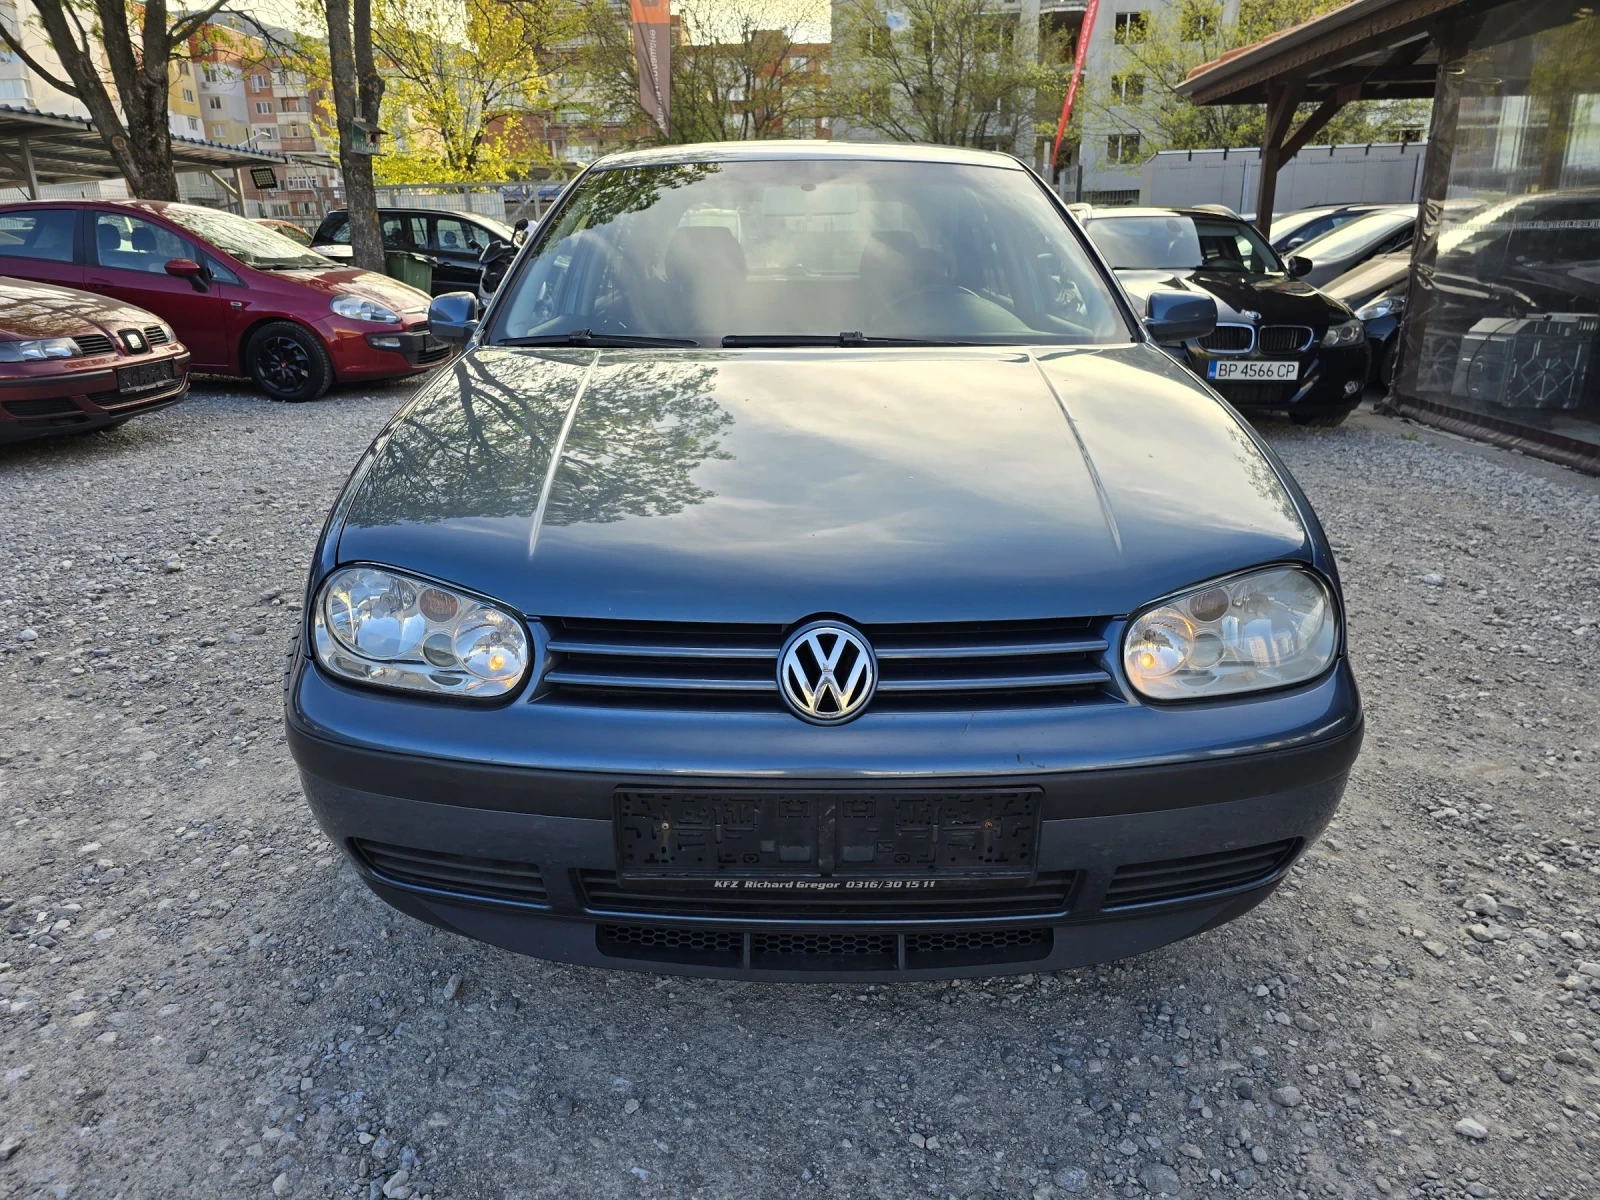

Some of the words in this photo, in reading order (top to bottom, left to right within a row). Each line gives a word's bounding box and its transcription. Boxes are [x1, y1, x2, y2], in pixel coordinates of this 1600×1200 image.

[1218, 363, 1238, 377] BP
[1240, 363, 1274, 378] 4566
[1277, 364, 1296, 378] CP
[714, 880, 738, 888] KFZ
[744, 880, 793, 889] Richard
[796, 881, 841, 890] Gregor
[845, 881, 902, 889] 0316/30
[905, 880, 919, 888] 15
[923, 880, 936, 888] 11
